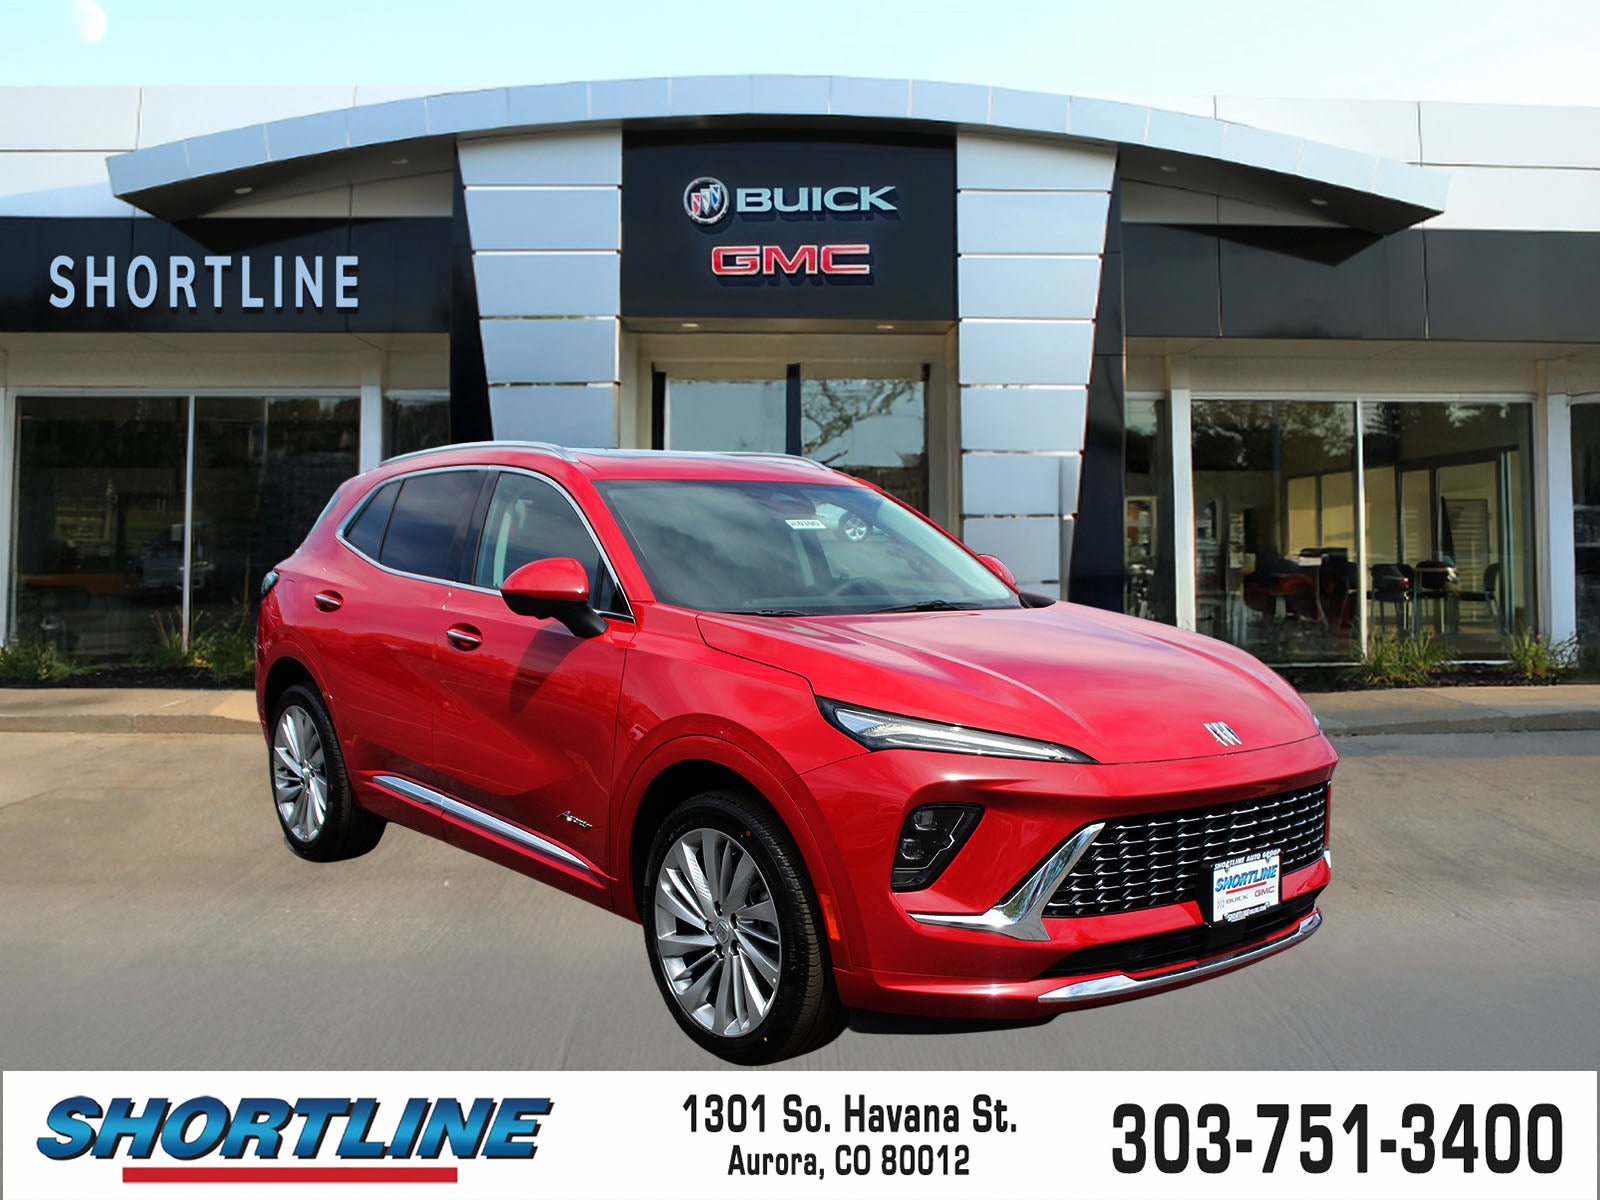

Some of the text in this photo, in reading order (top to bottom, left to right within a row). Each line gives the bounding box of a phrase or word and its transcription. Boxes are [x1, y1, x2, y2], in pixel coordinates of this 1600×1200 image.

[736, 185, 898, 213] BUICK
[711, 243, 871, 275] GMC
[49, 255, 359, 308] SHORTLINE
[1214, 857, 1245, 871] SHORTLINE
[1246, 853, 1262, 862] AUTO
[1215, 864, 1278, 892] SHORTLINE
[1254, 886, 1275, 897] GMC
